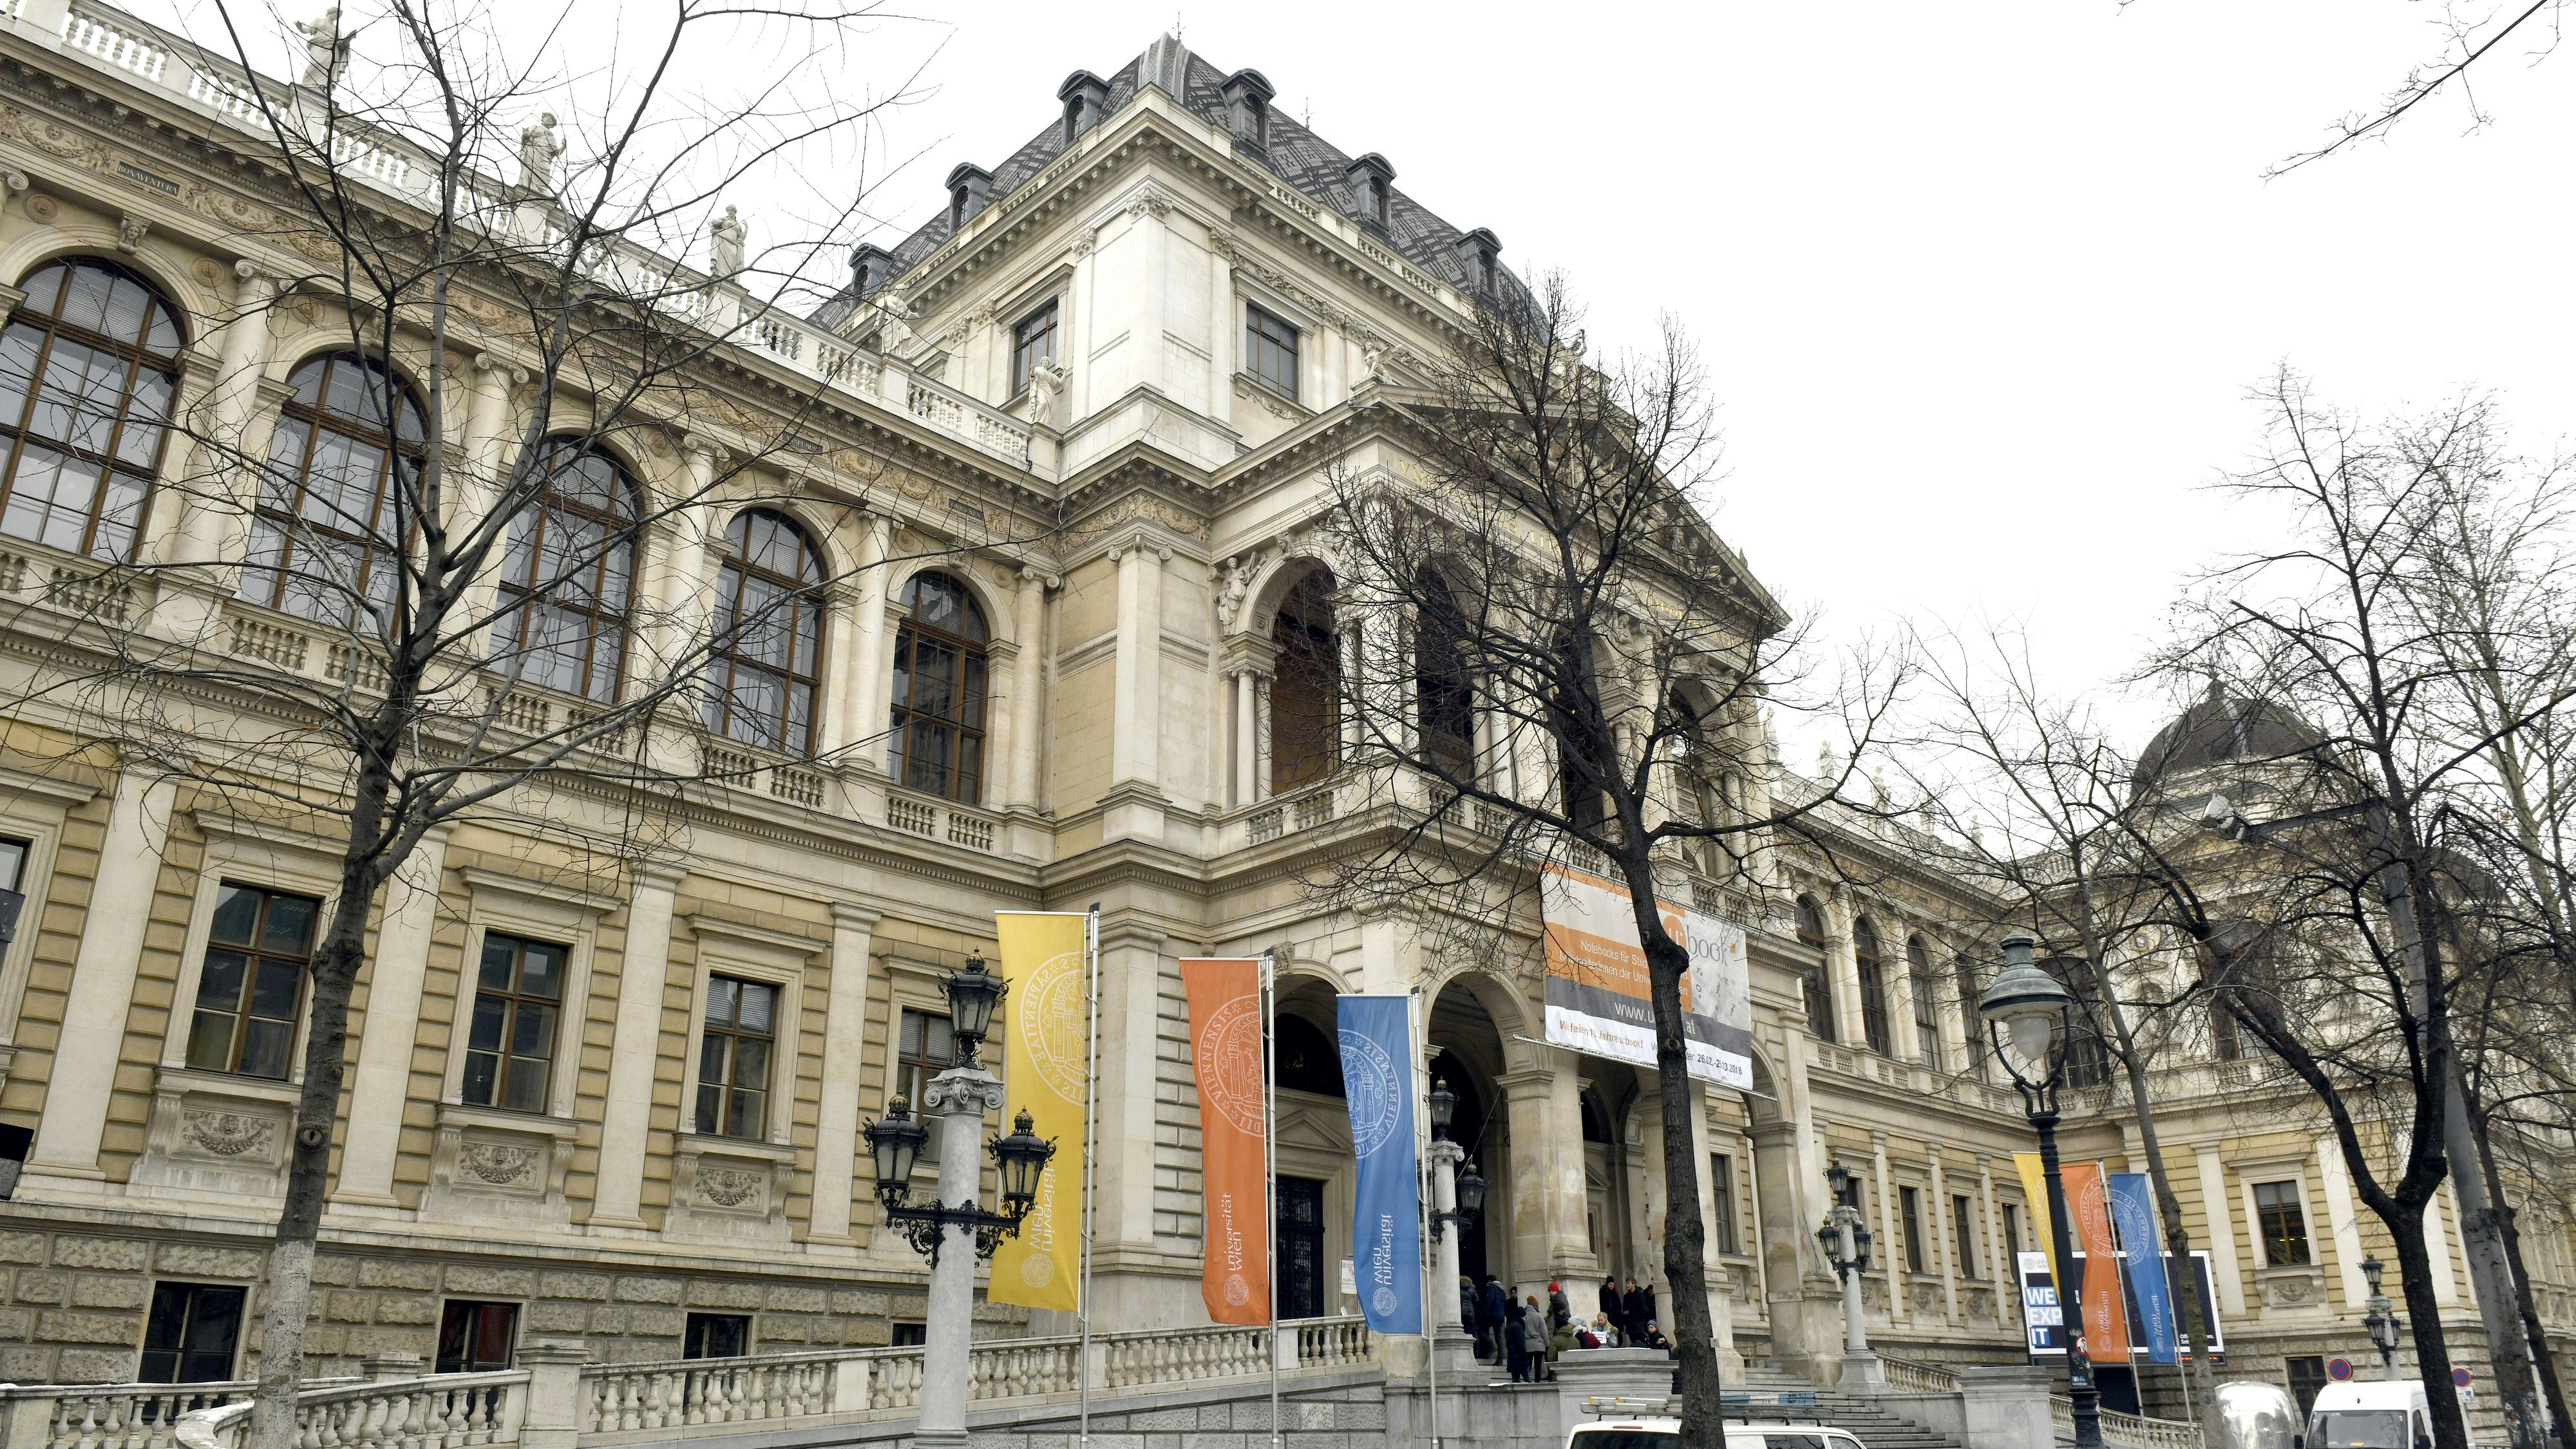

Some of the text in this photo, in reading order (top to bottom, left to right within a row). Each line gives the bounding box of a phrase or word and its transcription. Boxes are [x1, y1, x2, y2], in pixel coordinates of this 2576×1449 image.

[1580, 939, 1619, 960] Notebooks
[1620, 951, 1629, 963] für
[1620, 967, 1631, 980] der
[1599, 1030, 1618, 1043] Jahre
[1202, 1007, 1233, 1101] VIENNENSIS
[1222, 1192, 1237, 1271] universität
[1233, 1231, 1243, 1271] wien
[2025, 1288, 2056, 1305] WE
[2029, 1308, 2062, 1324] EXP
[2031, 1328, 2048, 1345] IT
